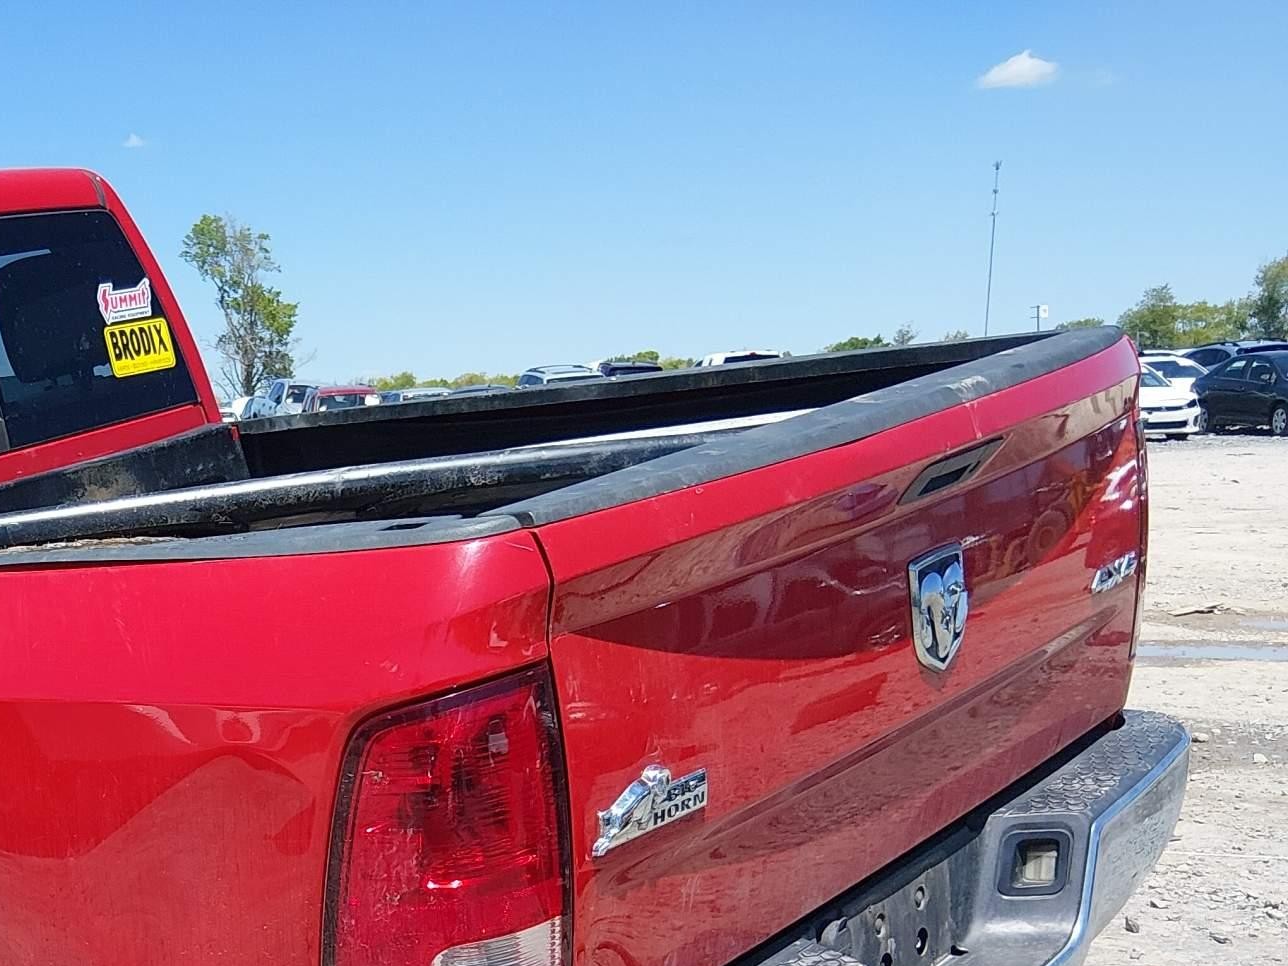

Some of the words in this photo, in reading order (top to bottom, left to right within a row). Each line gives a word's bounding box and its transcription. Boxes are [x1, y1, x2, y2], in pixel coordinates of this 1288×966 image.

[101, 287, 149, 314] SUMMIT
[108, 323, 169, 362] BRODIX
[653, 791, 705, 826] HORN
